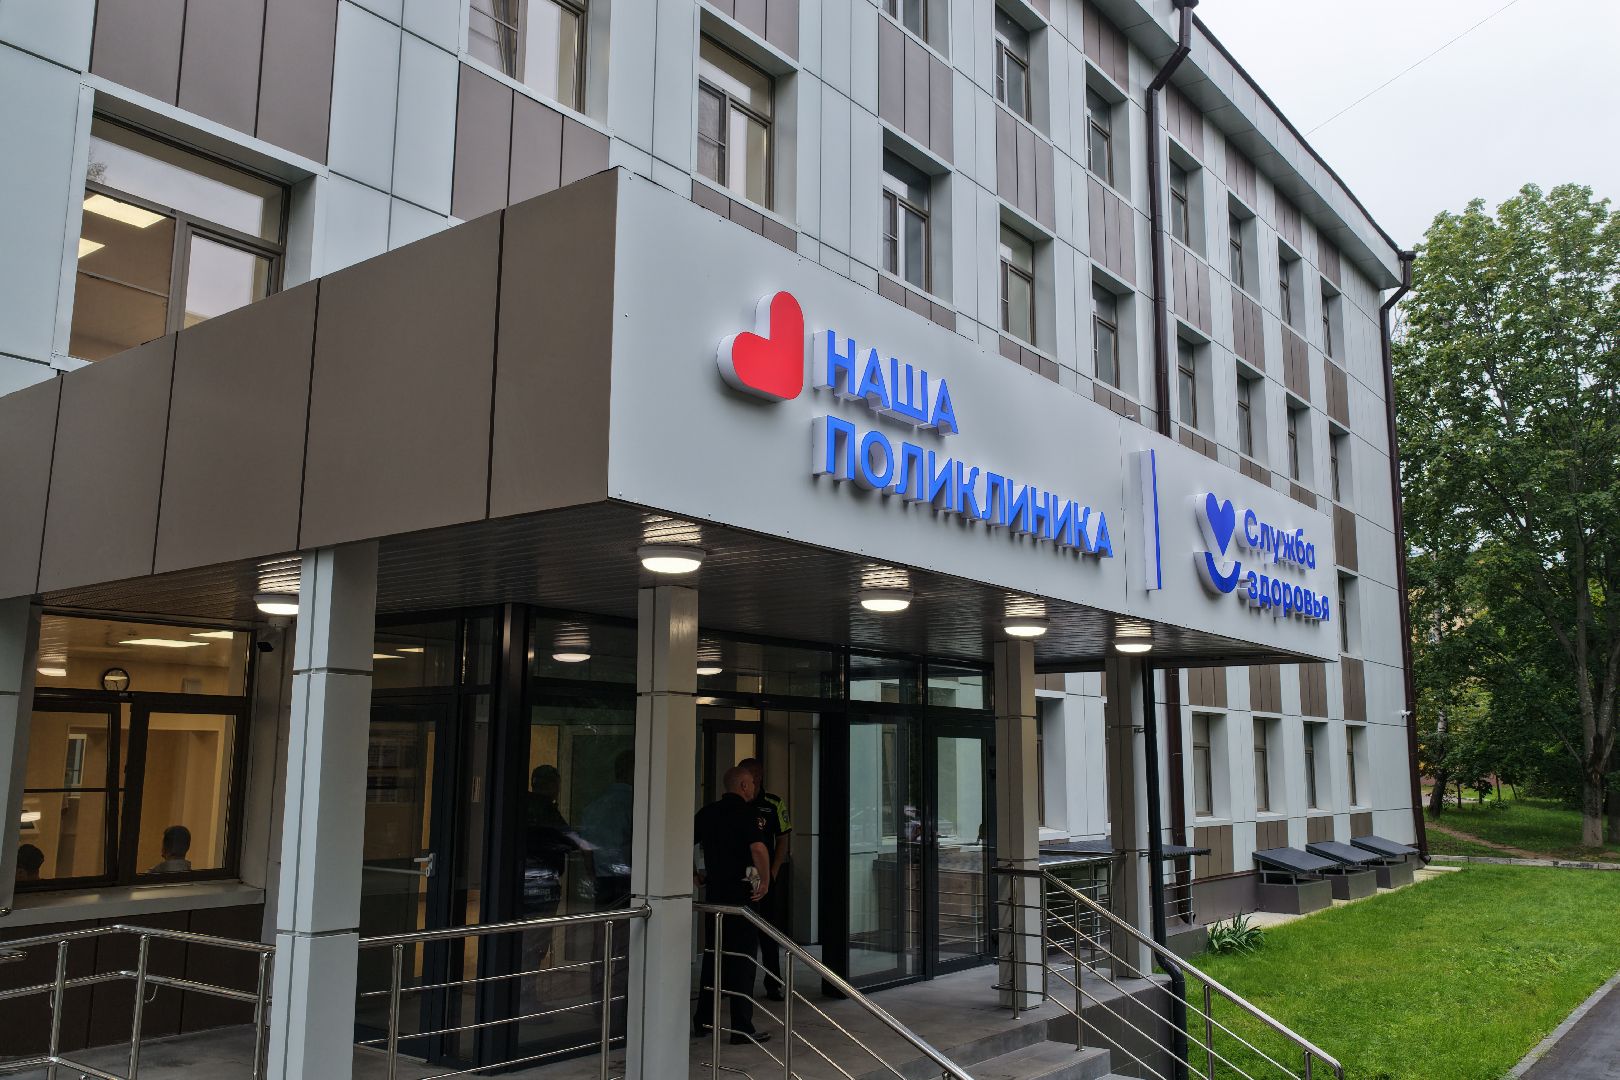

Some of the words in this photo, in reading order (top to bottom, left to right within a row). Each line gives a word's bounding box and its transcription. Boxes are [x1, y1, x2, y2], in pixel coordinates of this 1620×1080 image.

[826, 329, 959, 435] НАША
[825, 414, 1114, 558] ПОЛИКЛИНИКА
[1244, 508, 1316, 570] Служба
[1246, 570, 1330, 622] здоровья
